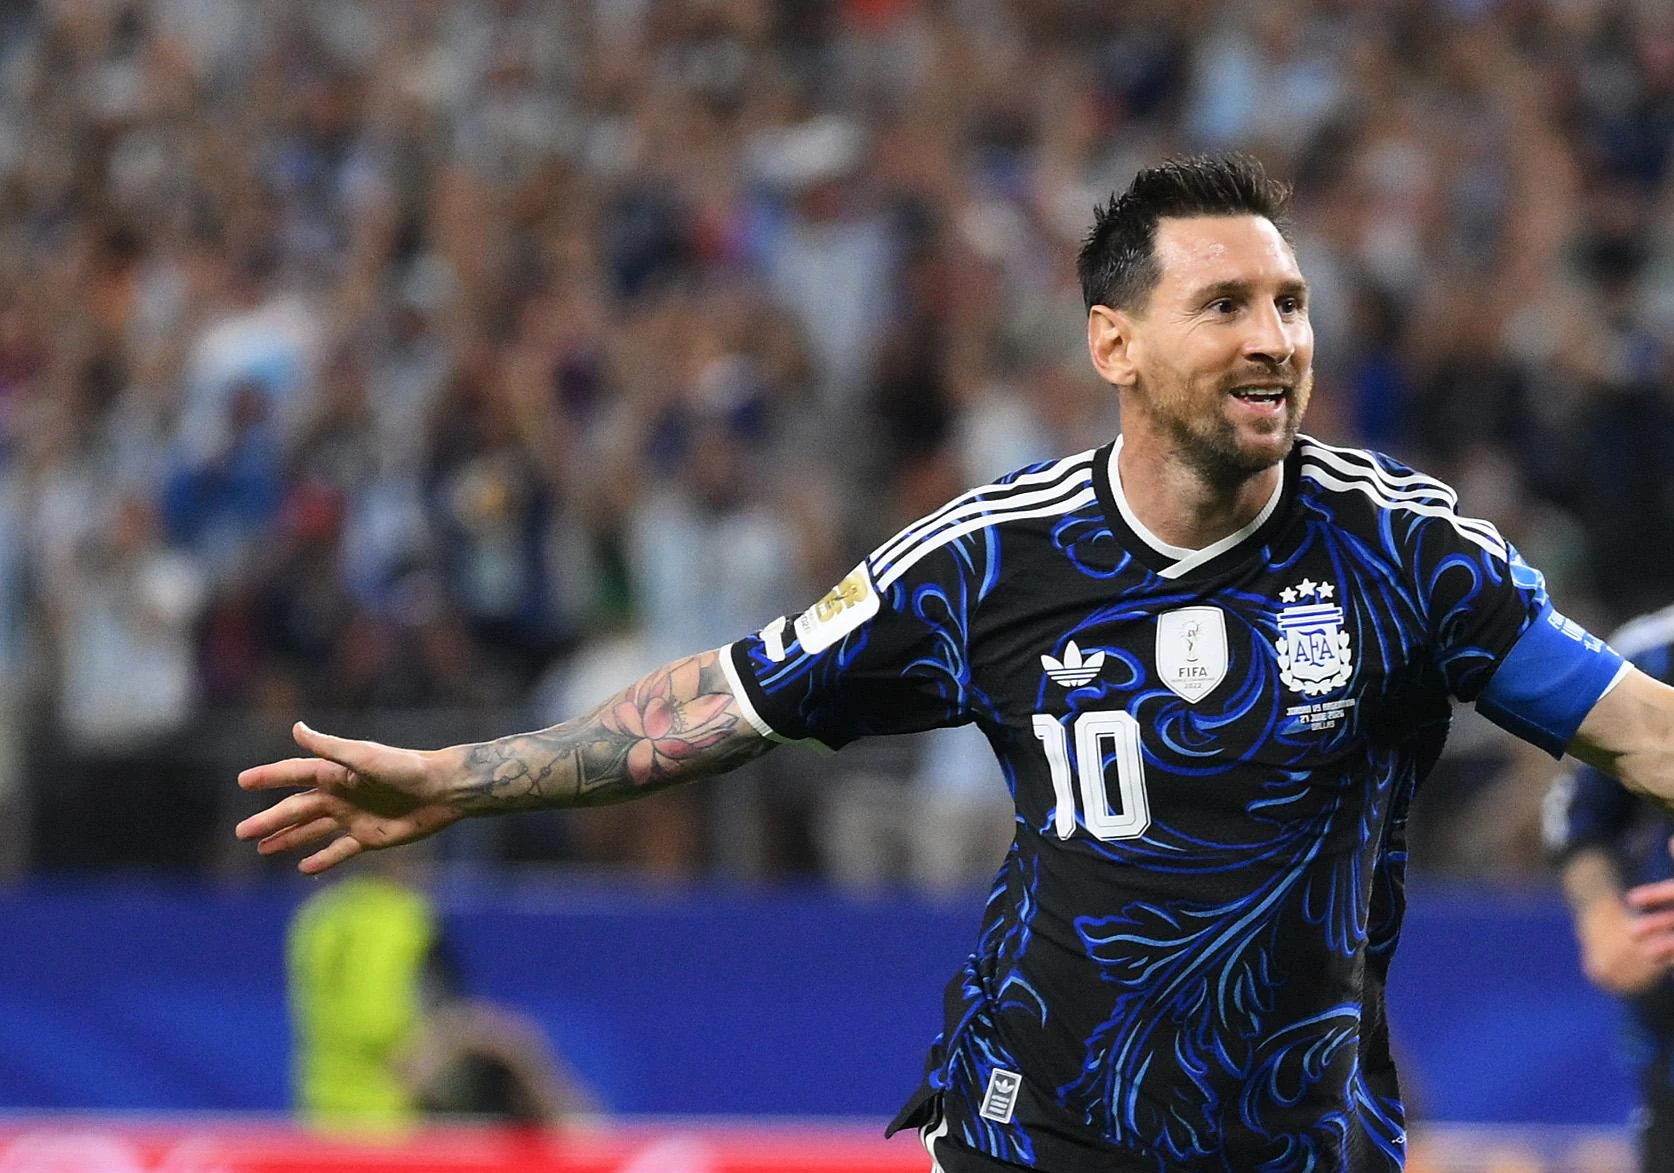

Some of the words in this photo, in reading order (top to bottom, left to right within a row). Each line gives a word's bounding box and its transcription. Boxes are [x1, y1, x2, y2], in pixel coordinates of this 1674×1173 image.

[1295, 628, 1335, 667] AFA
[1178, 666, 1208, 678] FIFA
[1032, 710, 1151, 841] 10
